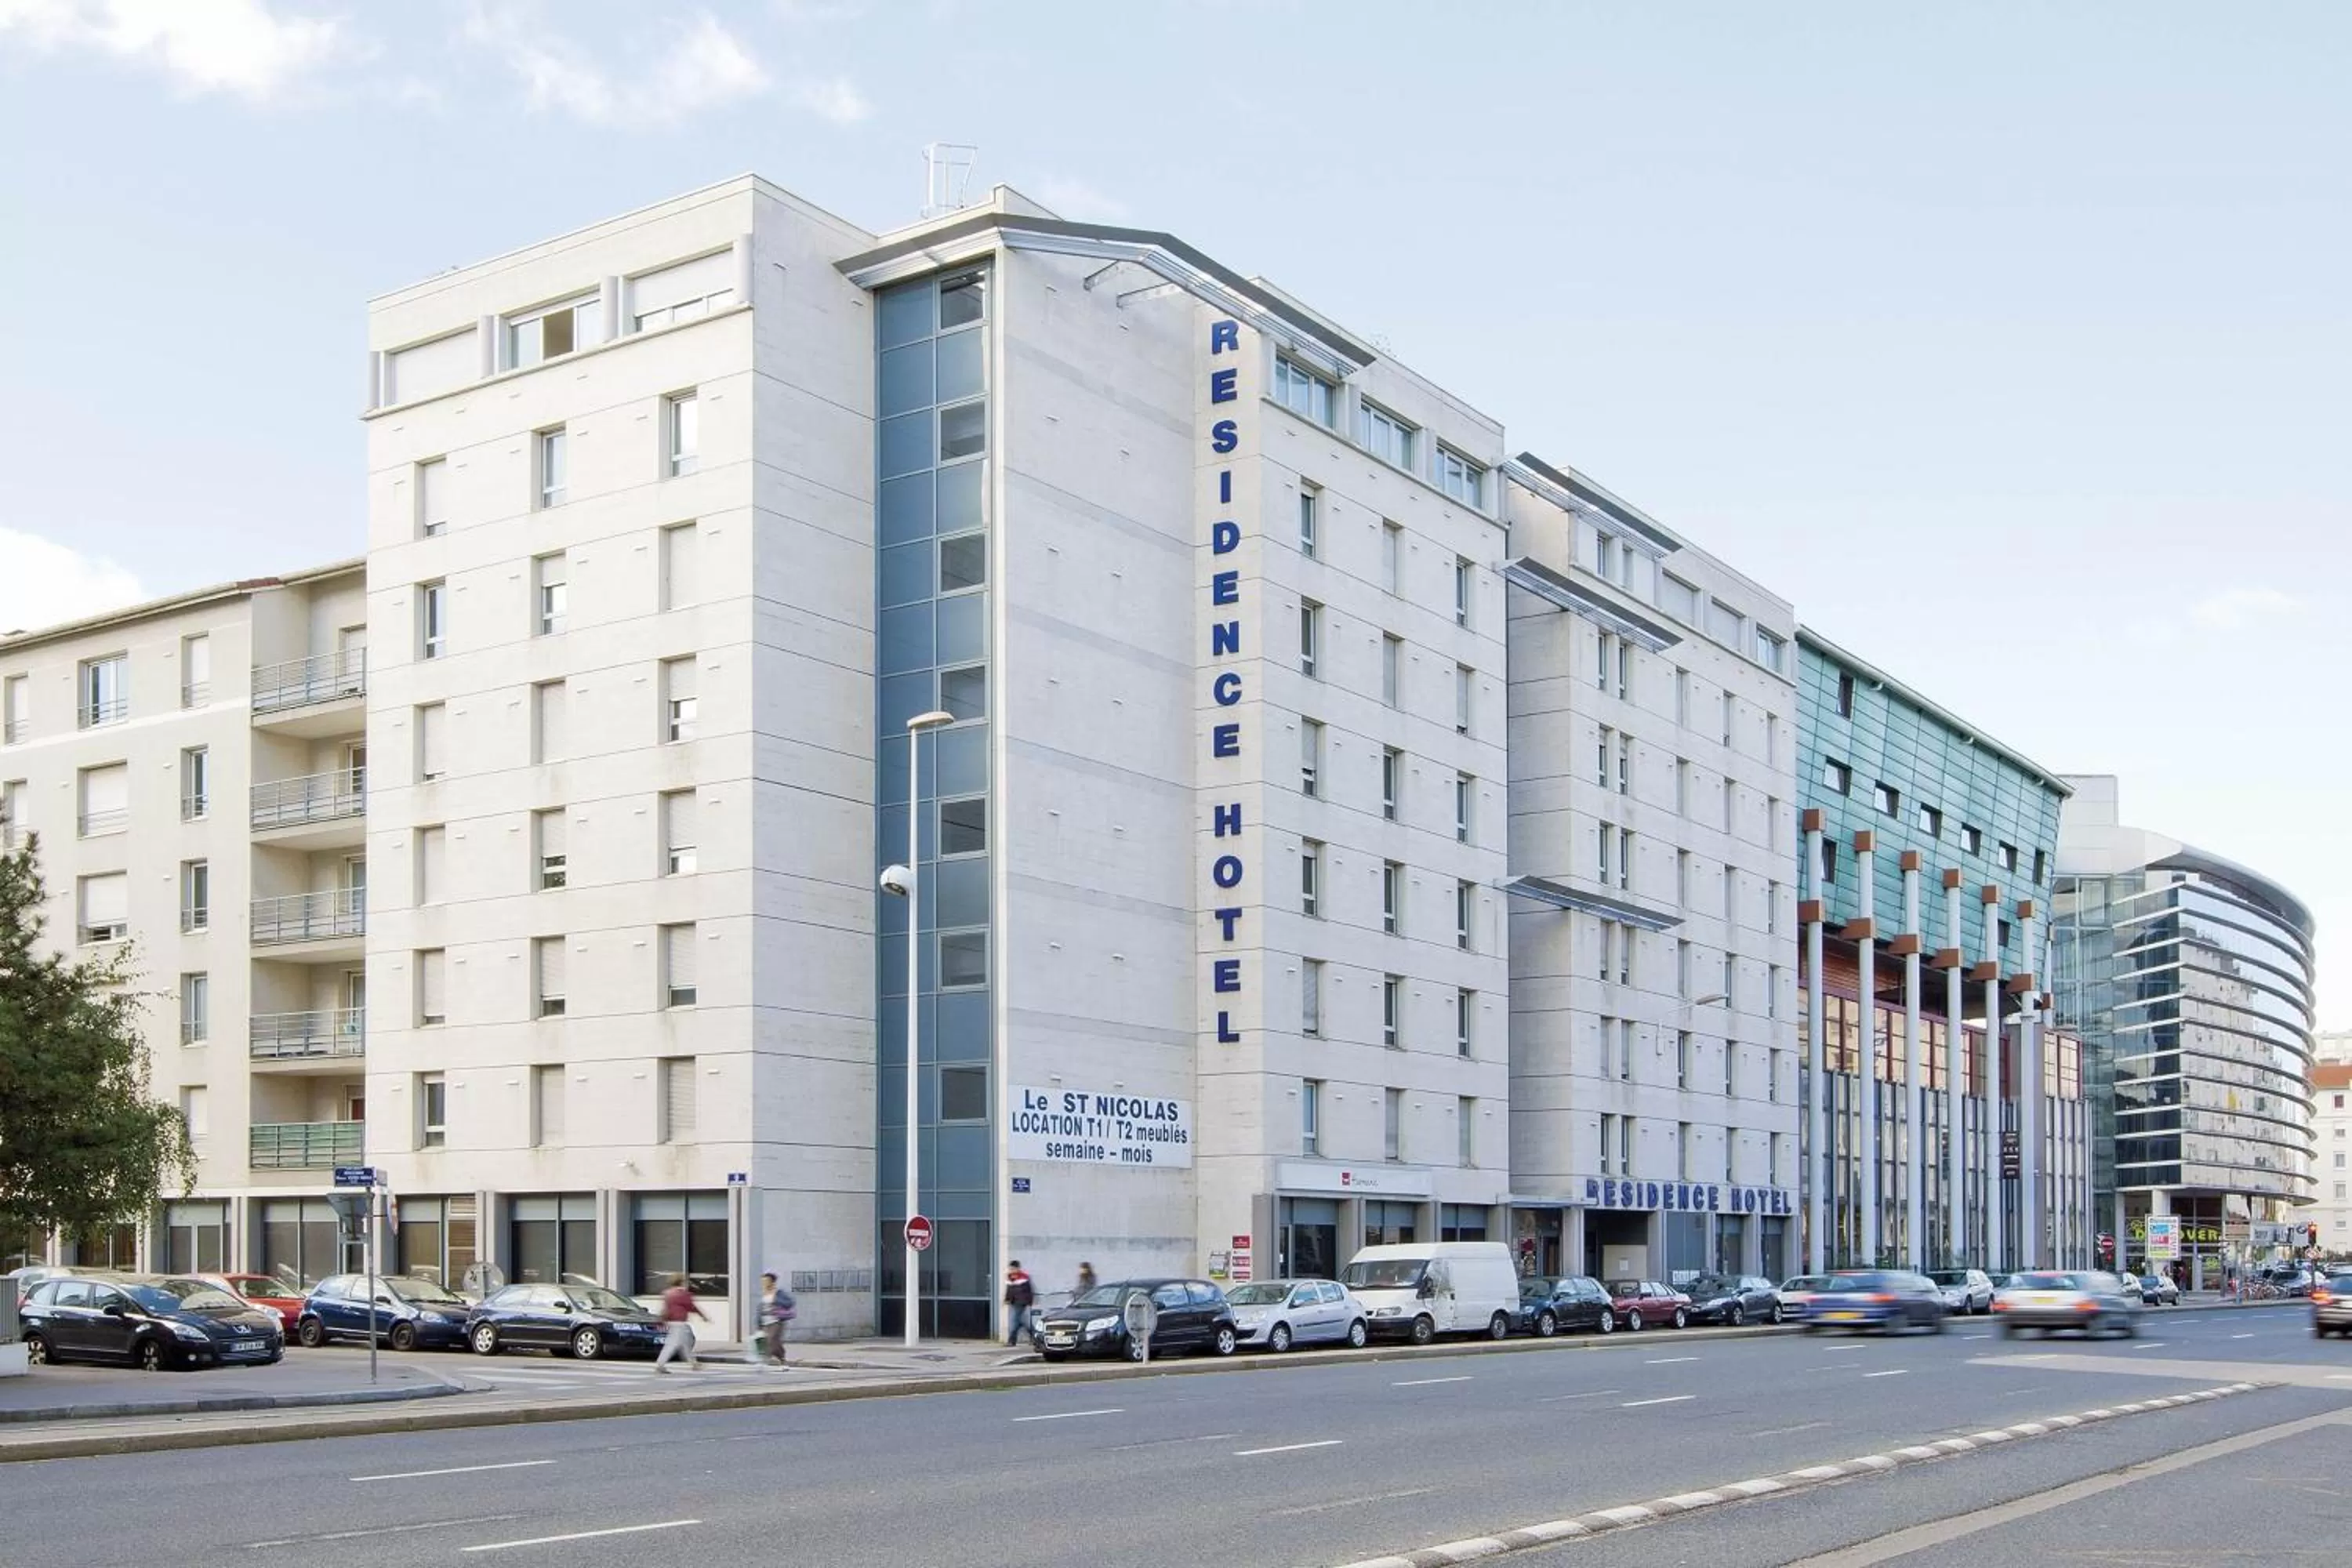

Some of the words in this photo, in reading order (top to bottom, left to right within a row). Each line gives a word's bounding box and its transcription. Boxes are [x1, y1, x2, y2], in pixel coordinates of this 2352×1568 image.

[1211, 321, 1242, 758] RESIDENCE
[1213, 803, 1243, 1043] HOTEL
[1025, 1089, 1048, 1111] Le
[1064, 1092, 1088, 1114] ST
[1096, 1095, 1178, 1121] NICOLAS
[1012, 1111, 1083, 1136] LOCATION
[1116, 1120, 1133, 1140] T2
[1136, 1123, 1188, 1144] meublés
[1046, 1140, 1105, 1160] semaine
[1122, 1144, 1152, 1163] mois
[1586, 1178, 1719, 1210] RESIDENCE
[1730, 1188, 1791, 1214] HOTEL
